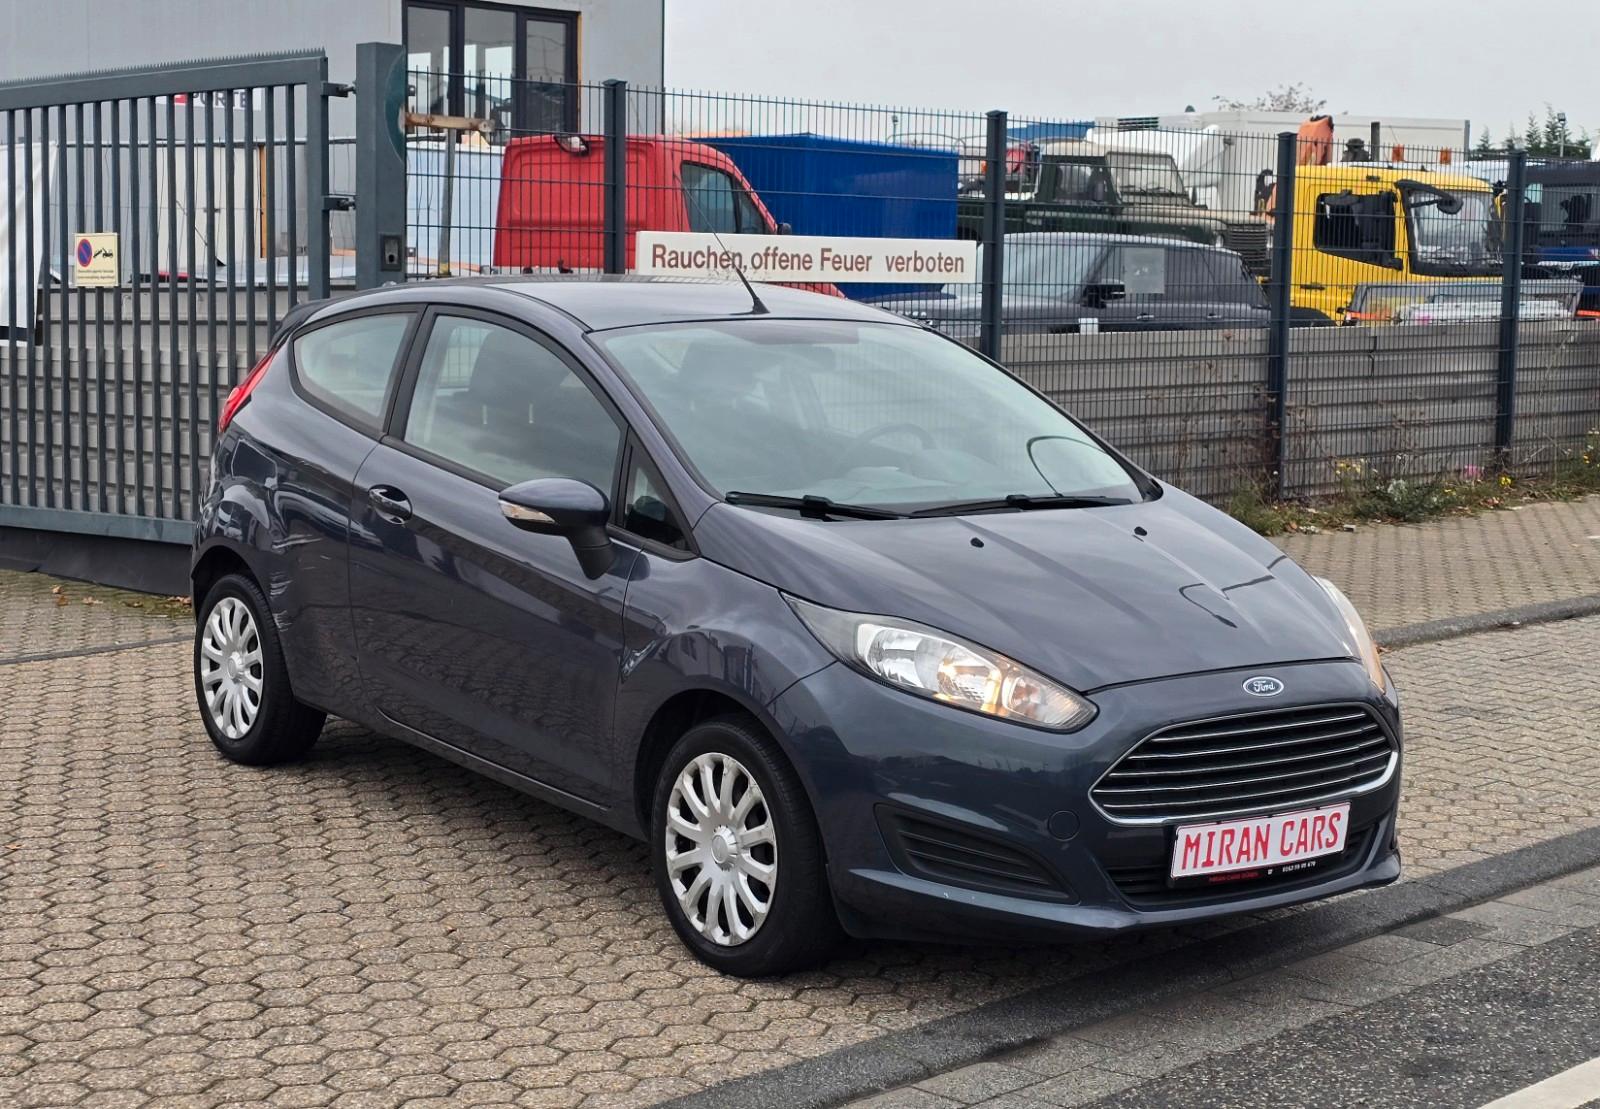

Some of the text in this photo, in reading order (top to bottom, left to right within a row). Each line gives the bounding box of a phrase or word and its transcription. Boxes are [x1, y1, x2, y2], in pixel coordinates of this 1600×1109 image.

[652, 243, 965, 273] Rauchen, offene Feuer verboten
[1253, 680, 1276, 692] Ford
[1181, 812, 1342, 870] MIRAN CARS
